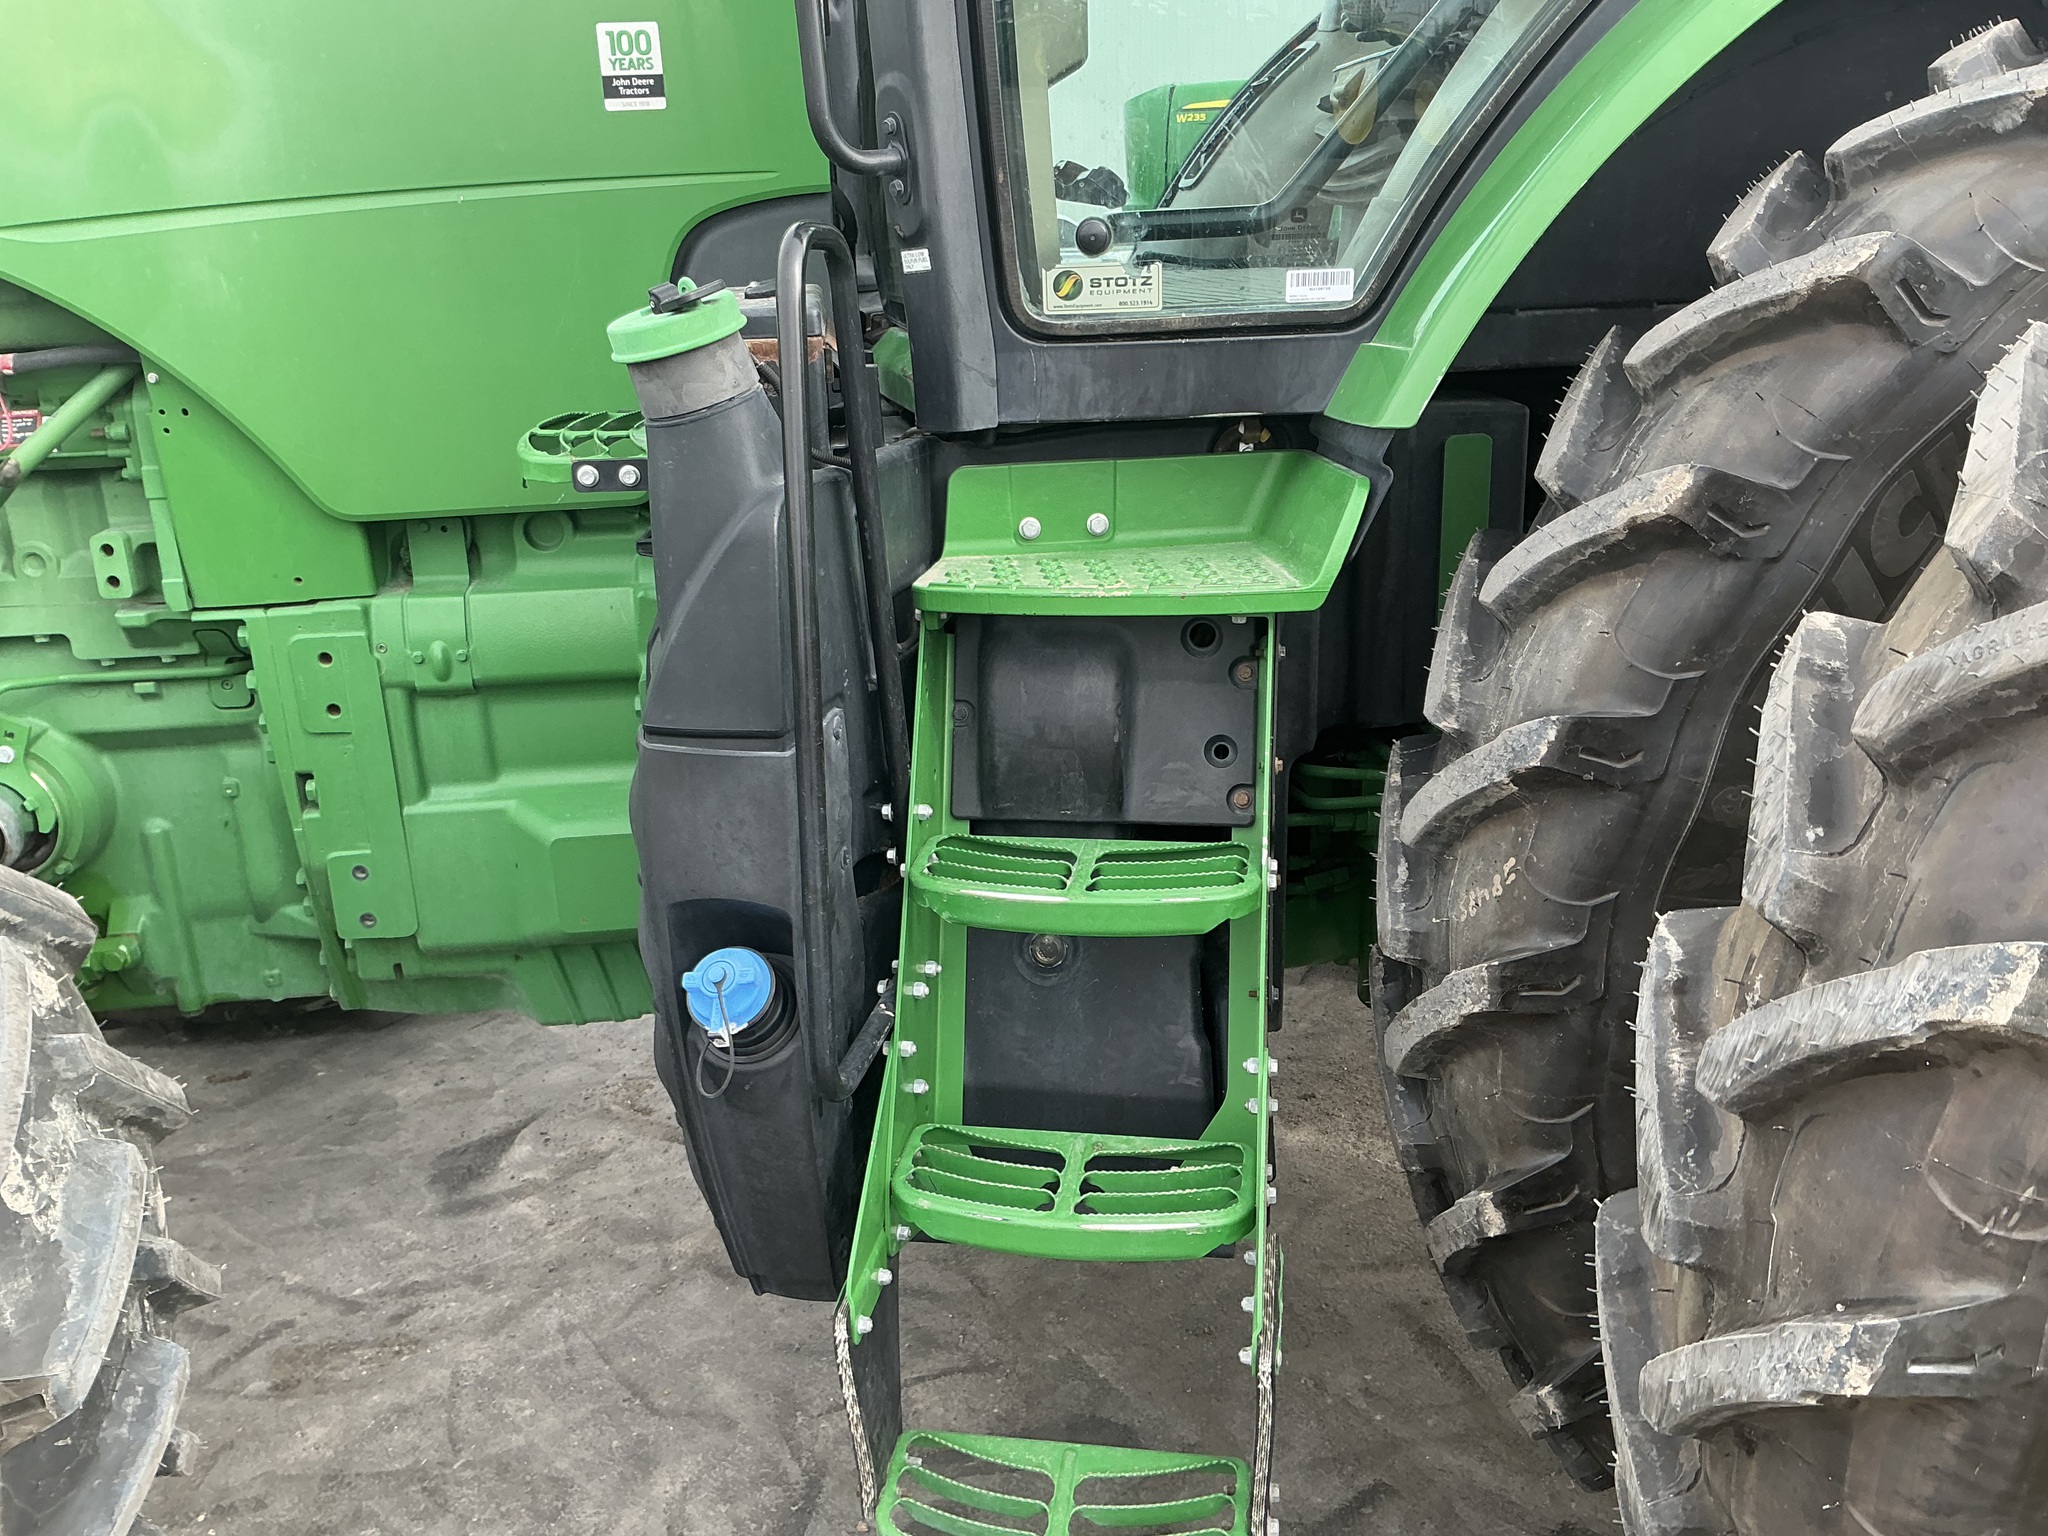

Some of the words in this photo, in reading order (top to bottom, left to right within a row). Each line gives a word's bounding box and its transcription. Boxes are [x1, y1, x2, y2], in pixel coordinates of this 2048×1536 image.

[604, 29, 652, 56] 100
[608, 57, 654, 71] YEARS
[612, 77, 631, 87] John
[631, 77, 655, 86] Deere
[618, 86, 650, 95] Tractors
[1176, 113, 1207, 123] W235
[1089, 275, 1153, 288] STOTZ
[1089, 288, 1153, 297] EQUIPMENT
